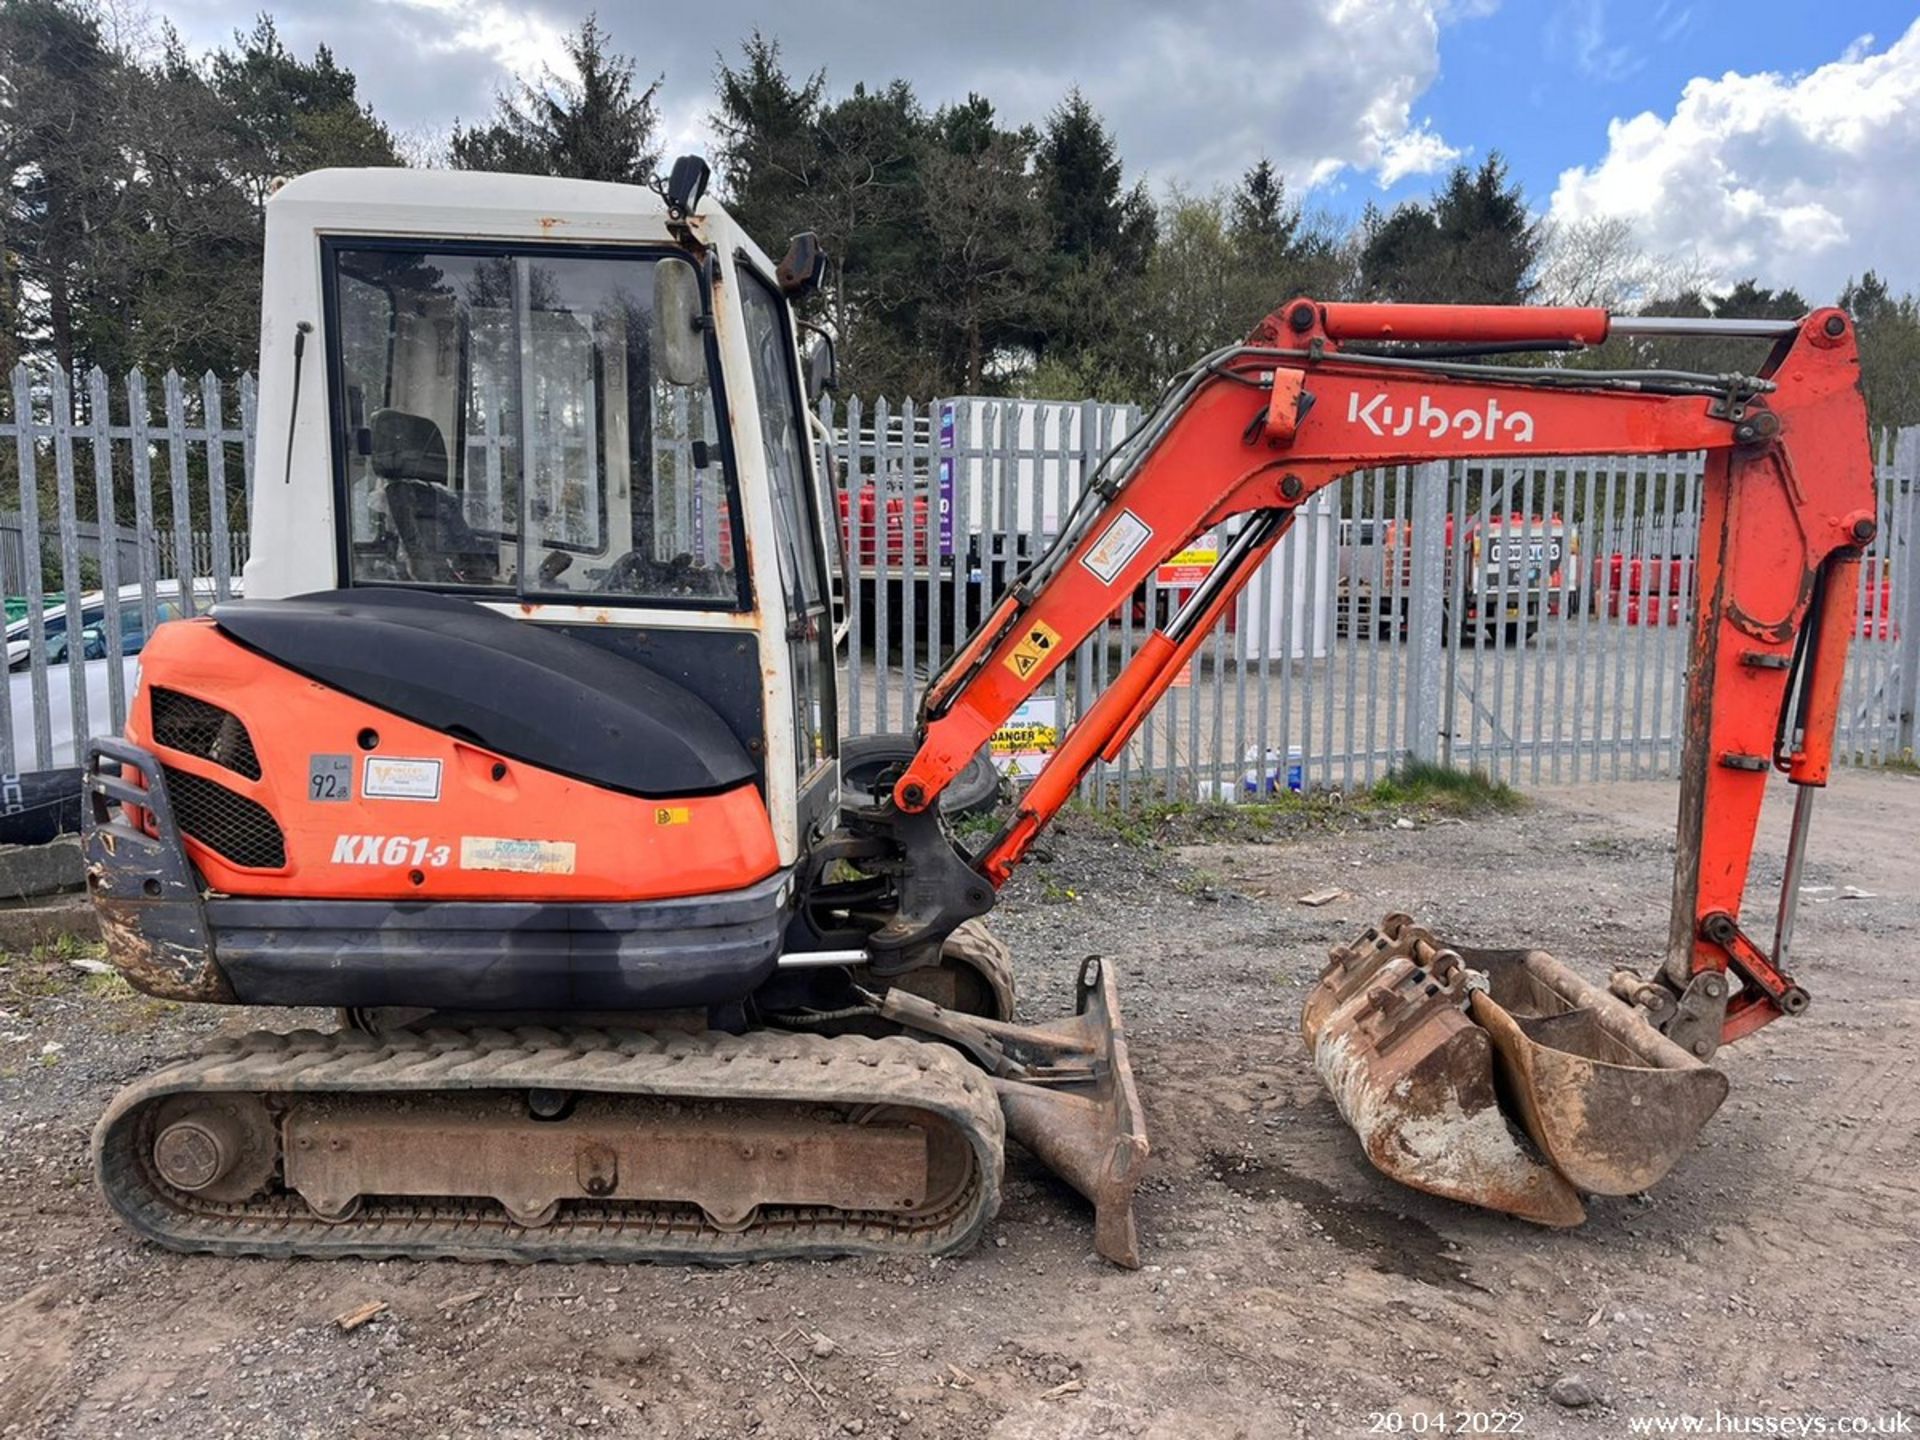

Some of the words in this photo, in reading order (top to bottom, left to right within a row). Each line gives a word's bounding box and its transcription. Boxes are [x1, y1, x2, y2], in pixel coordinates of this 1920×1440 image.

[1348, 392, 1534, 442] Kubota
[990, 731, 1035, 742] DANGER
[312, 775, 336, 798] 92
[331, 835, 450, 867] KX61-3
